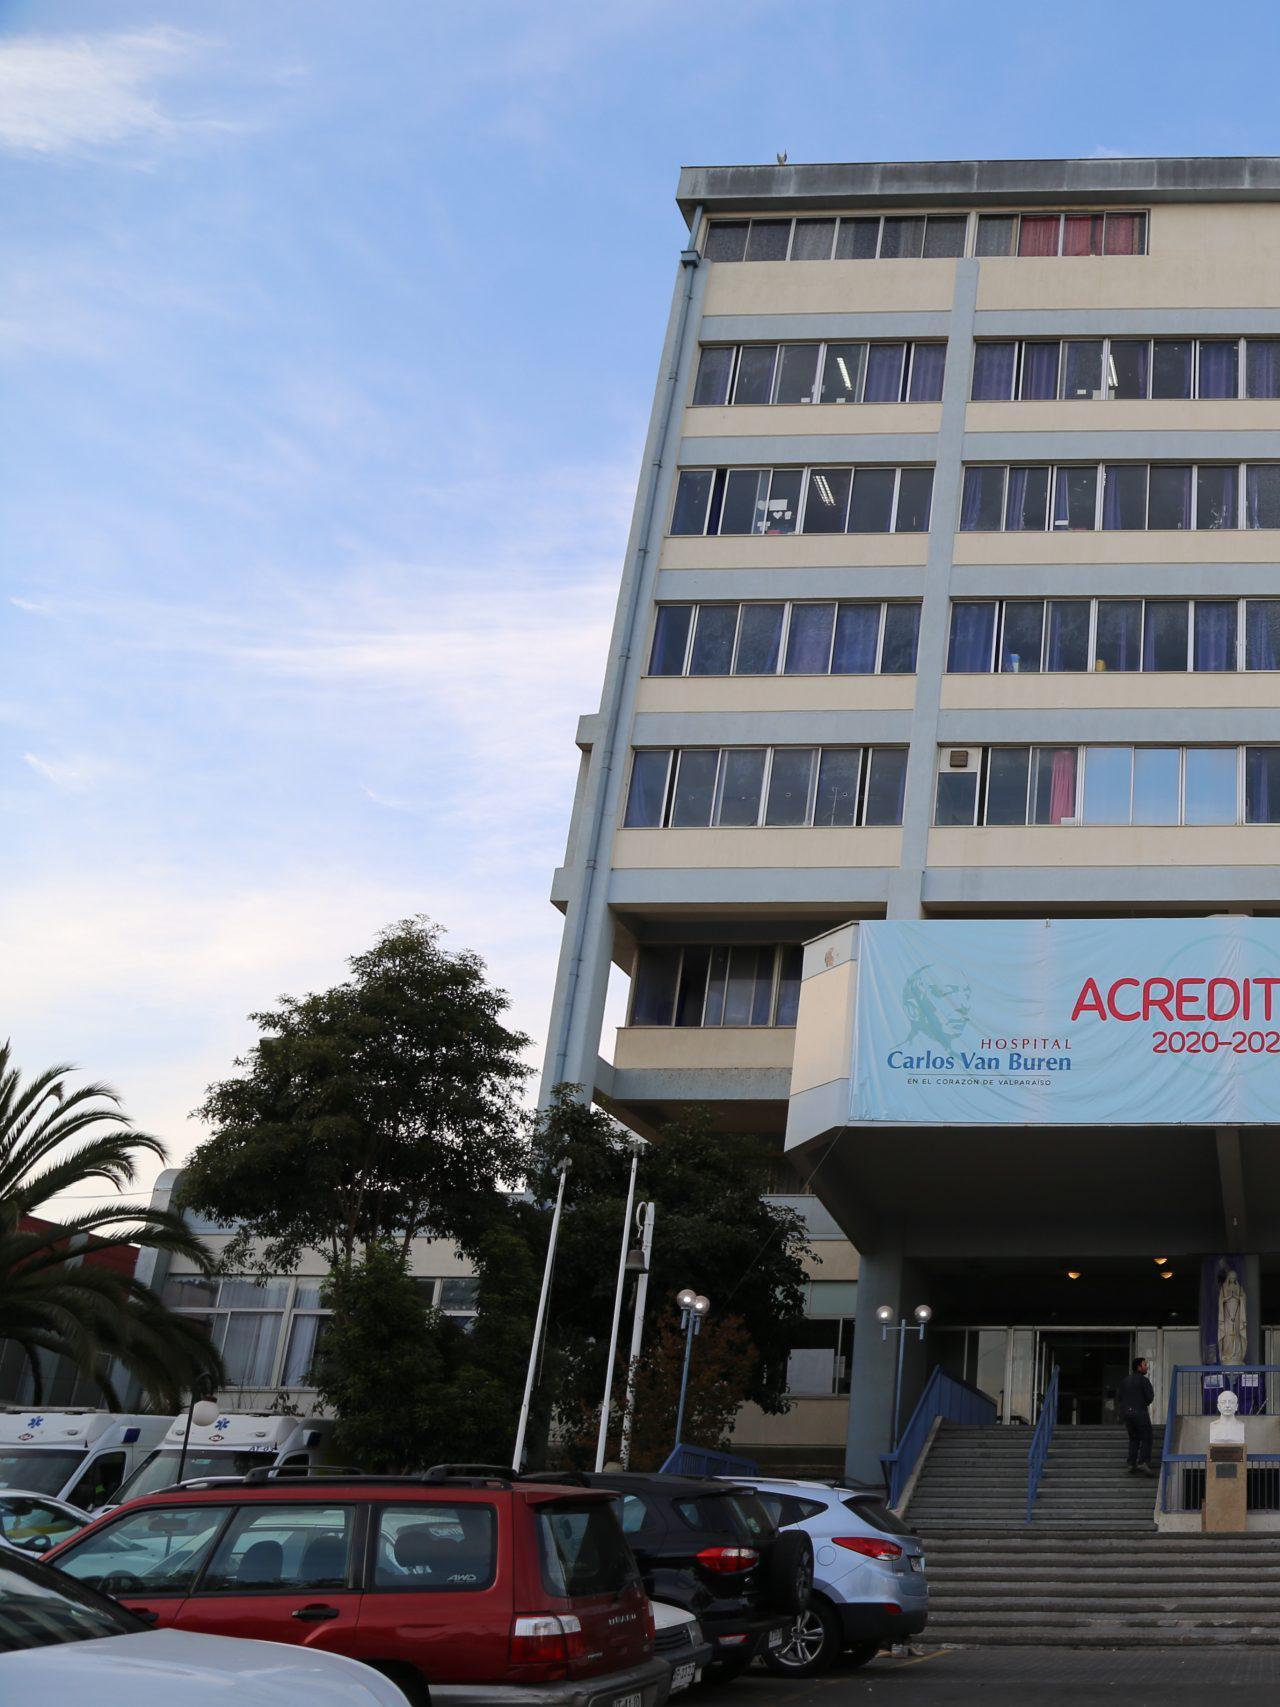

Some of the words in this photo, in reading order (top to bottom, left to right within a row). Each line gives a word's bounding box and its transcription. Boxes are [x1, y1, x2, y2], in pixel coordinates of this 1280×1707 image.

[980, 1038, 1073, 1050] HOSPITAL
[887, 1050, 955, 1070] Carlos
[960, 1052, 1000, 1070] Van
[1008, 1052, 1072, 1071] Buren
[936, 1076, 979, 1086] CORAZÓN
